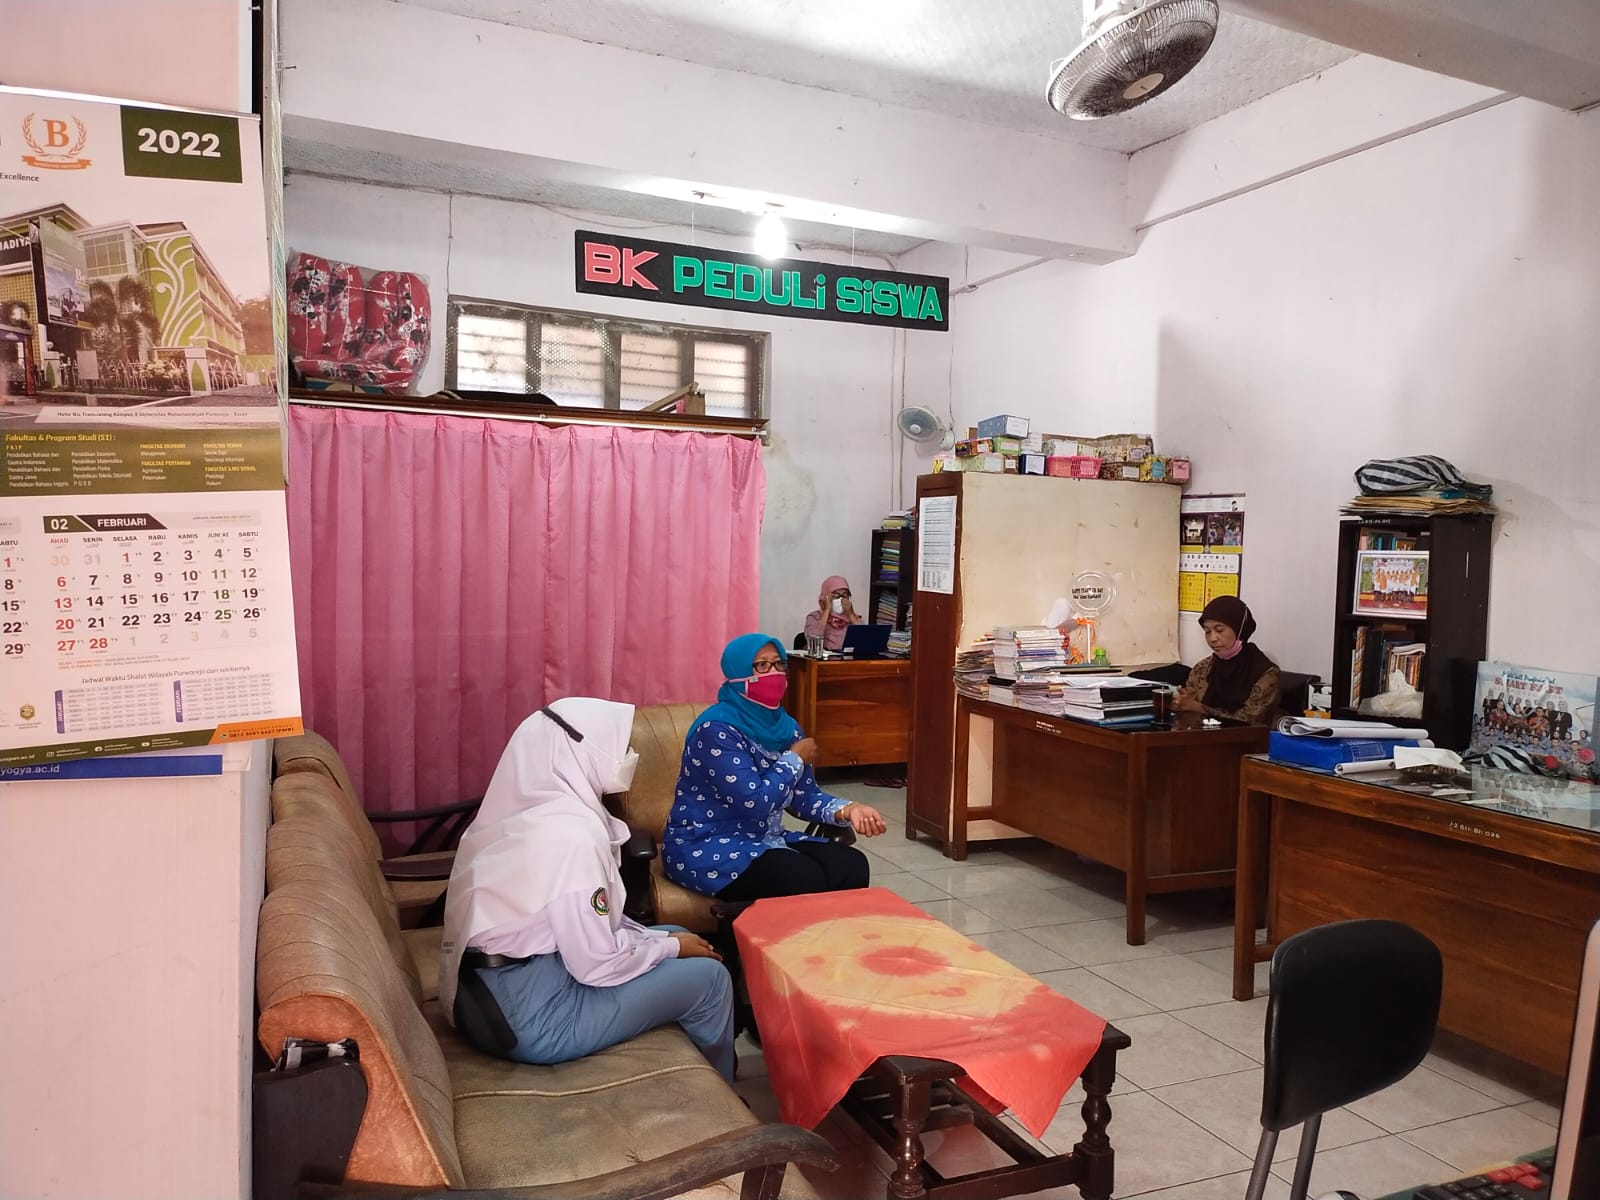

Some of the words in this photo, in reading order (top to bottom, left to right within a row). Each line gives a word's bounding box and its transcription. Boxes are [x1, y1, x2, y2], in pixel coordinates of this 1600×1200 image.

[137, 127, 221, 158] 2022
[0, 172, 40, 182] Excellence
[584, 241, 660, 291] BK
[46, 434, 77, 442] Program
[50, 518, 68, 530] 02
[98, 518, 147, 527] FEBRUARI
[122, 552, 130, 562] 1
[152, 552, 162, 562] 2
[184, 550, 192, 560] 3
[214, 548, 223, 558] 4
[243, 548, 252, 558] 5
[4, 578, 14, 590] 8
[56, 576, 66, 588] 6
[88, 574, 98, 586] 7
[122, 573, 132, 584] 8
[154, 572, 163, 582] 9
[182, 570, 198, 582] 10
[211, 569, 227, 580] 11
[240, 568, 257, 578] 12
[54, 598, 72, 608] 13
[86, 596, 104, 606] 14
[120, 594, 138, 605] 15
[152, 592, 169, 604] 16
[182, 590, 200, 602] 17
[213, 589, 230, 600] 18
[242, 588, 258, 598] 19
[1, 600, 20, 612] 15
[56, 618, 74, 630] 20
[88, 617, 105, 628] 21
[122, 614, 140, 626] 22
[153, 613, 171, 624] 23
[184, 611, 202, 622] 24
[214, 610, 232, 620] 25
[243, 608, 260, 618] 26
[2, 622, 22, 634] 22
[4, 643, 24, 655] 29
[57, 640, 76, 652] 27
[89, 638, 108, 650] 28
[126, 672, 146, 680] Shalat
